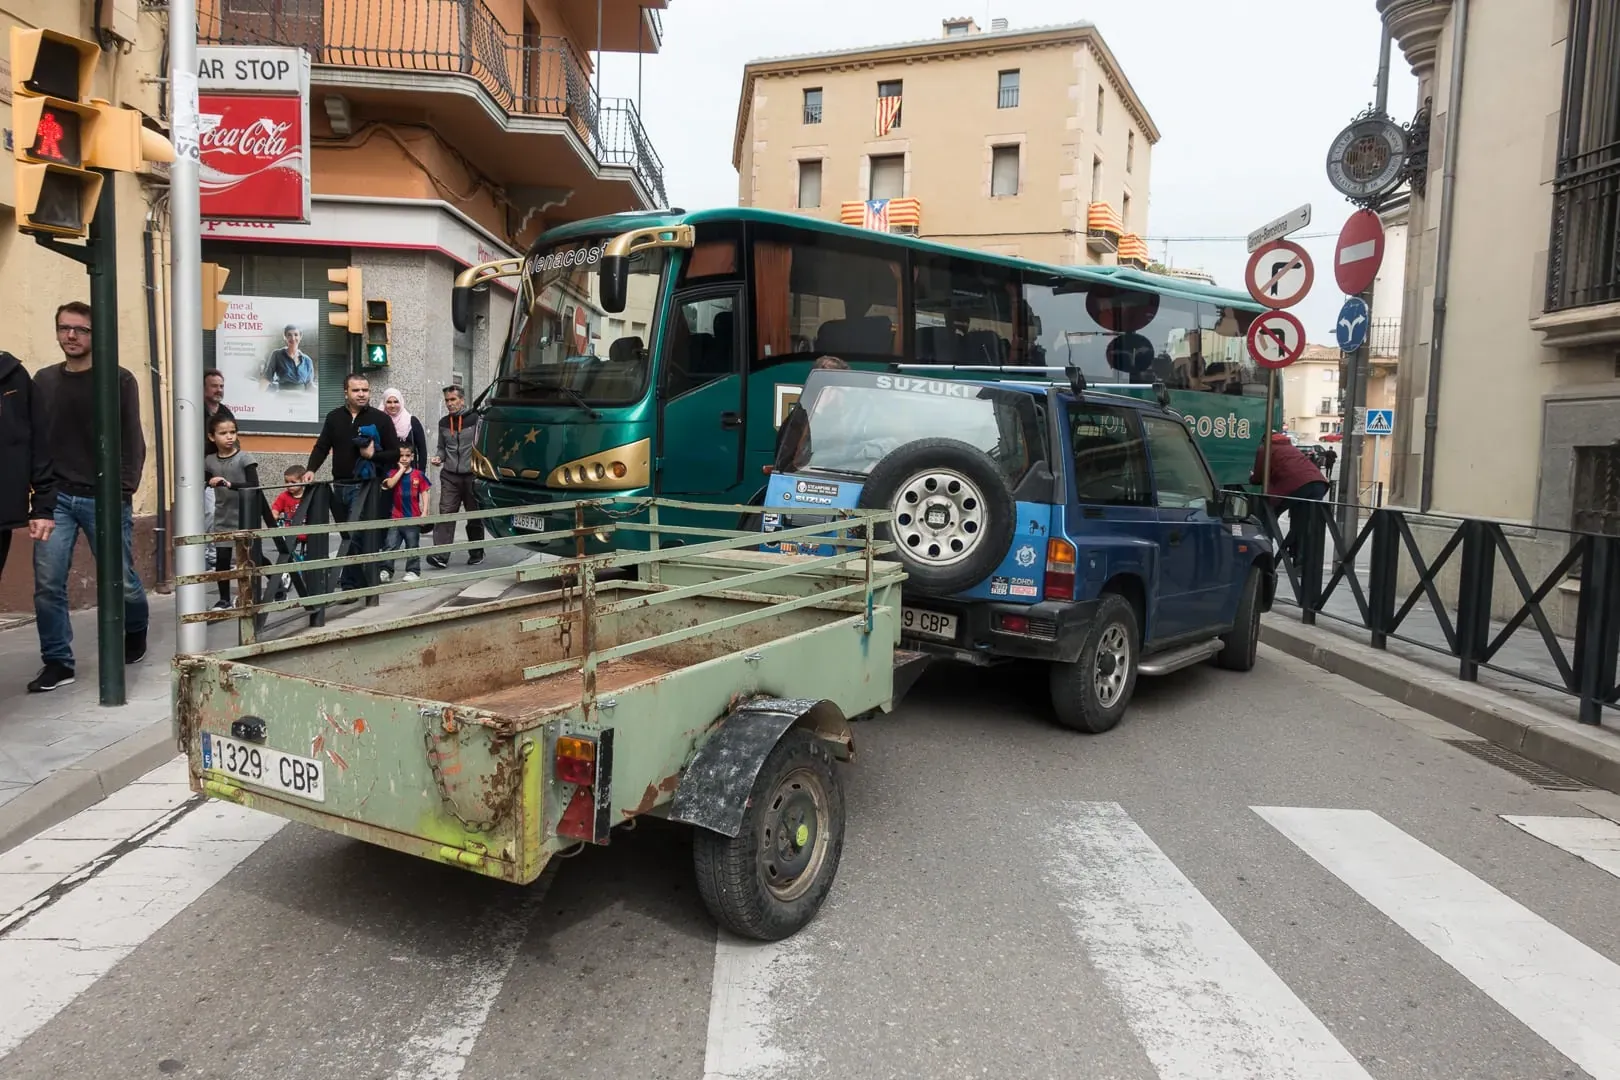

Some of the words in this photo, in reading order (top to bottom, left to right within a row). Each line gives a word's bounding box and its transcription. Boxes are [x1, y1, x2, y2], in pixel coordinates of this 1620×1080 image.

[198, 58, 224, 79] AR
[235, 59, 289, 81] STOP
[224, 321, 237, 330] les
[238, 322, 263, 331] PIME
[247, 312, 259, 320] de
[875, 375, 970, 398] SUZUKI
[920, 612, 950, 634] CBP
[216, 740, 263, 780] 1329
[279, 756, 320, 794] CBP
